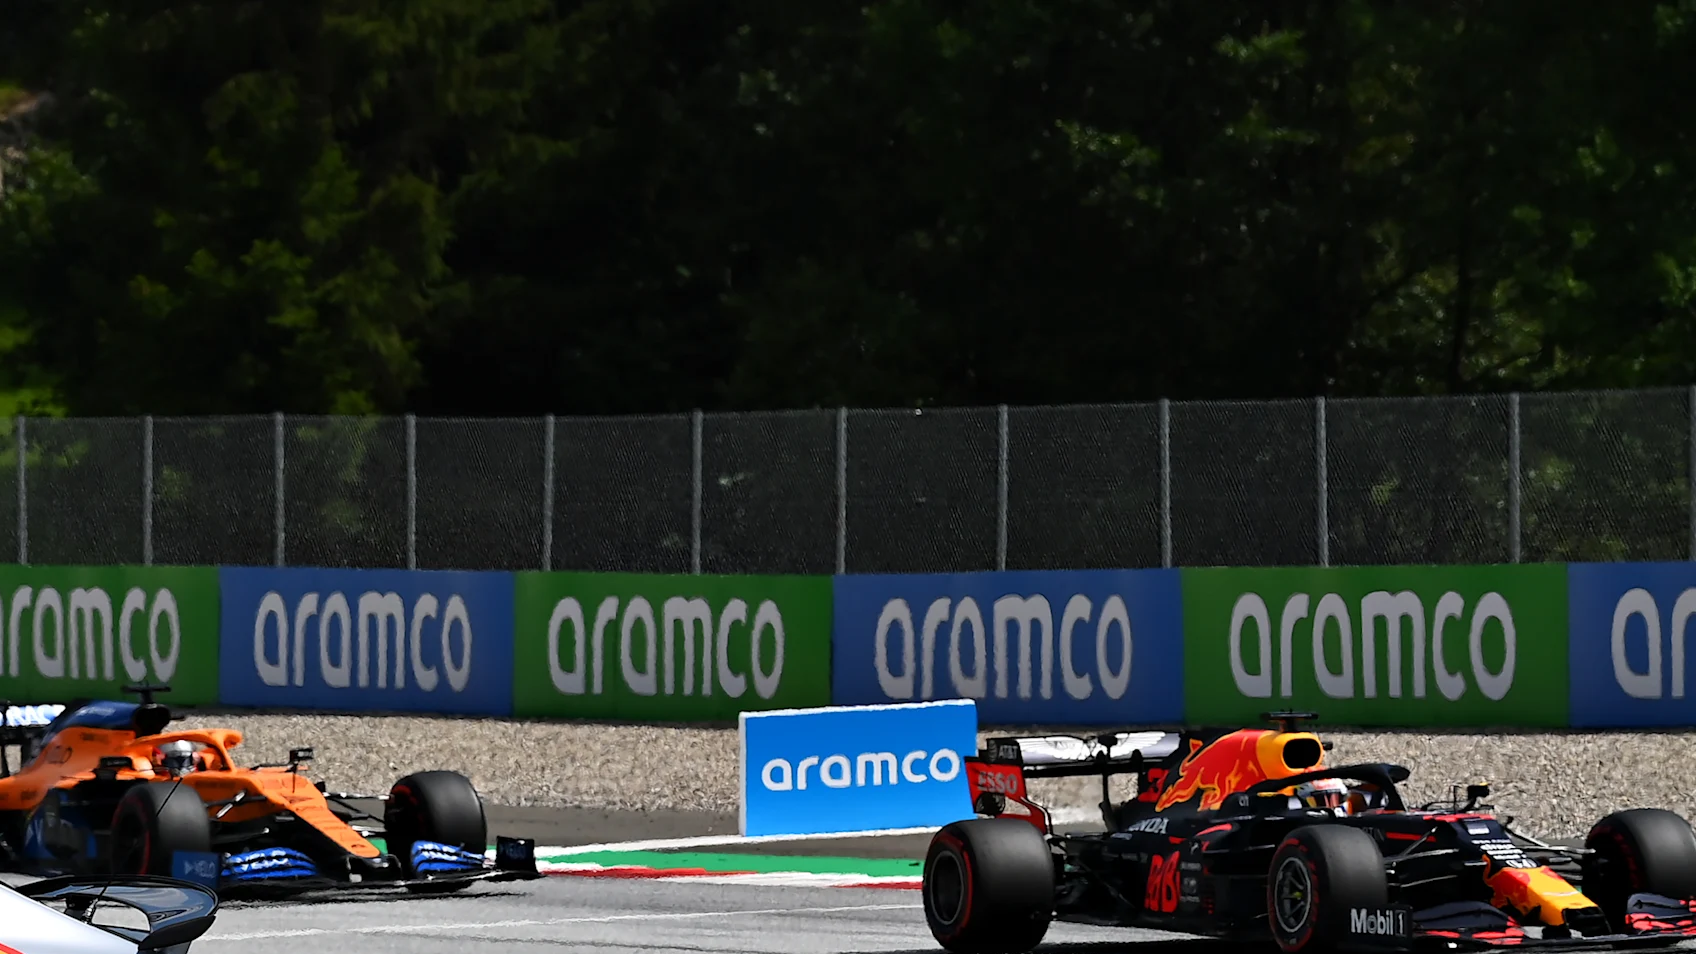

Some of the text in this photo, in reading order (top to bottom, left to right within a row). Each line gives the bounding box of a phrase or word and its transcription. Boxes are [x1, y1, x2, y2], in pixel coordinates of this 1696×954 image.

[254, 591, 472, 692] aramco
[547, 595, 784, 700] aramco
[875, 594, 1133, 700] aramco
[1229, 590, 1516, 701] aramco
[761, 749, 960, 791] aramco
[1351, 908, 1393, 935] Mobil
